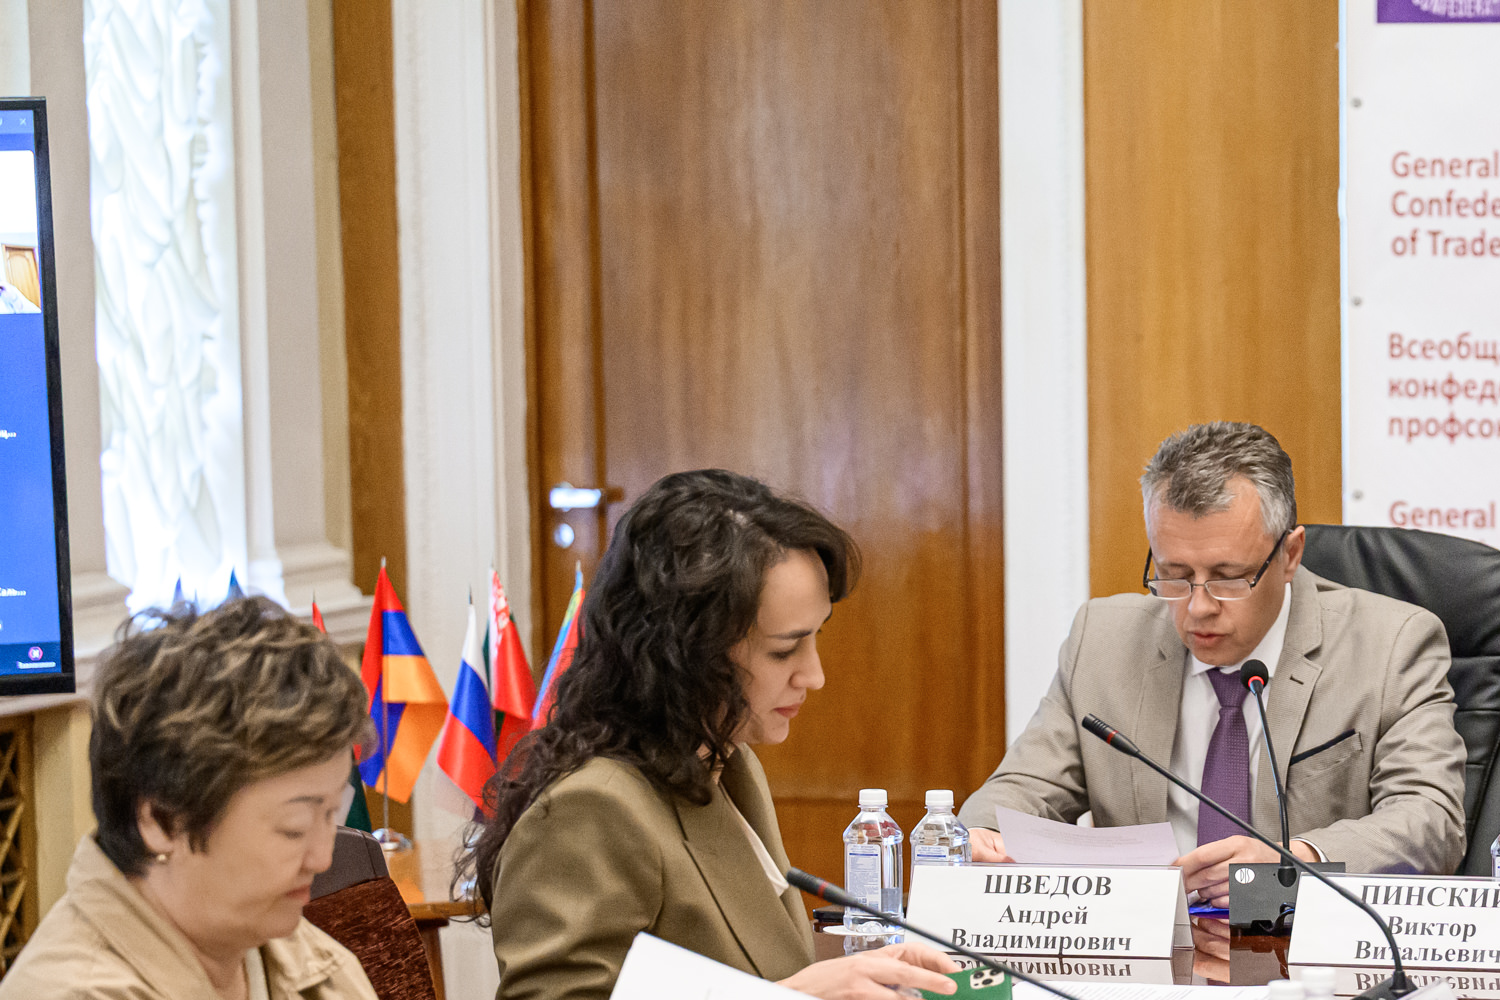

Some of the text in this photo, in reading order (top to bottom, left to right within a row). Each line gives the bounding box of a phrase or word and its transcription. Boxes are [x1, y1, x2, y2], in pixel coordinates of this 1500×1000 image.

[1392, 152, 1499, 178] General
[1391, 227, 1418, 257] of
[1389, 501, 1496, 529] General
[984, 874, 1112, 899] ШВЕДОВ
[998, 904, 1089, 927] Андрей
[1387, 915, 1477, 942] Виктор
[951, 927, 1132, 952] Владимирович
